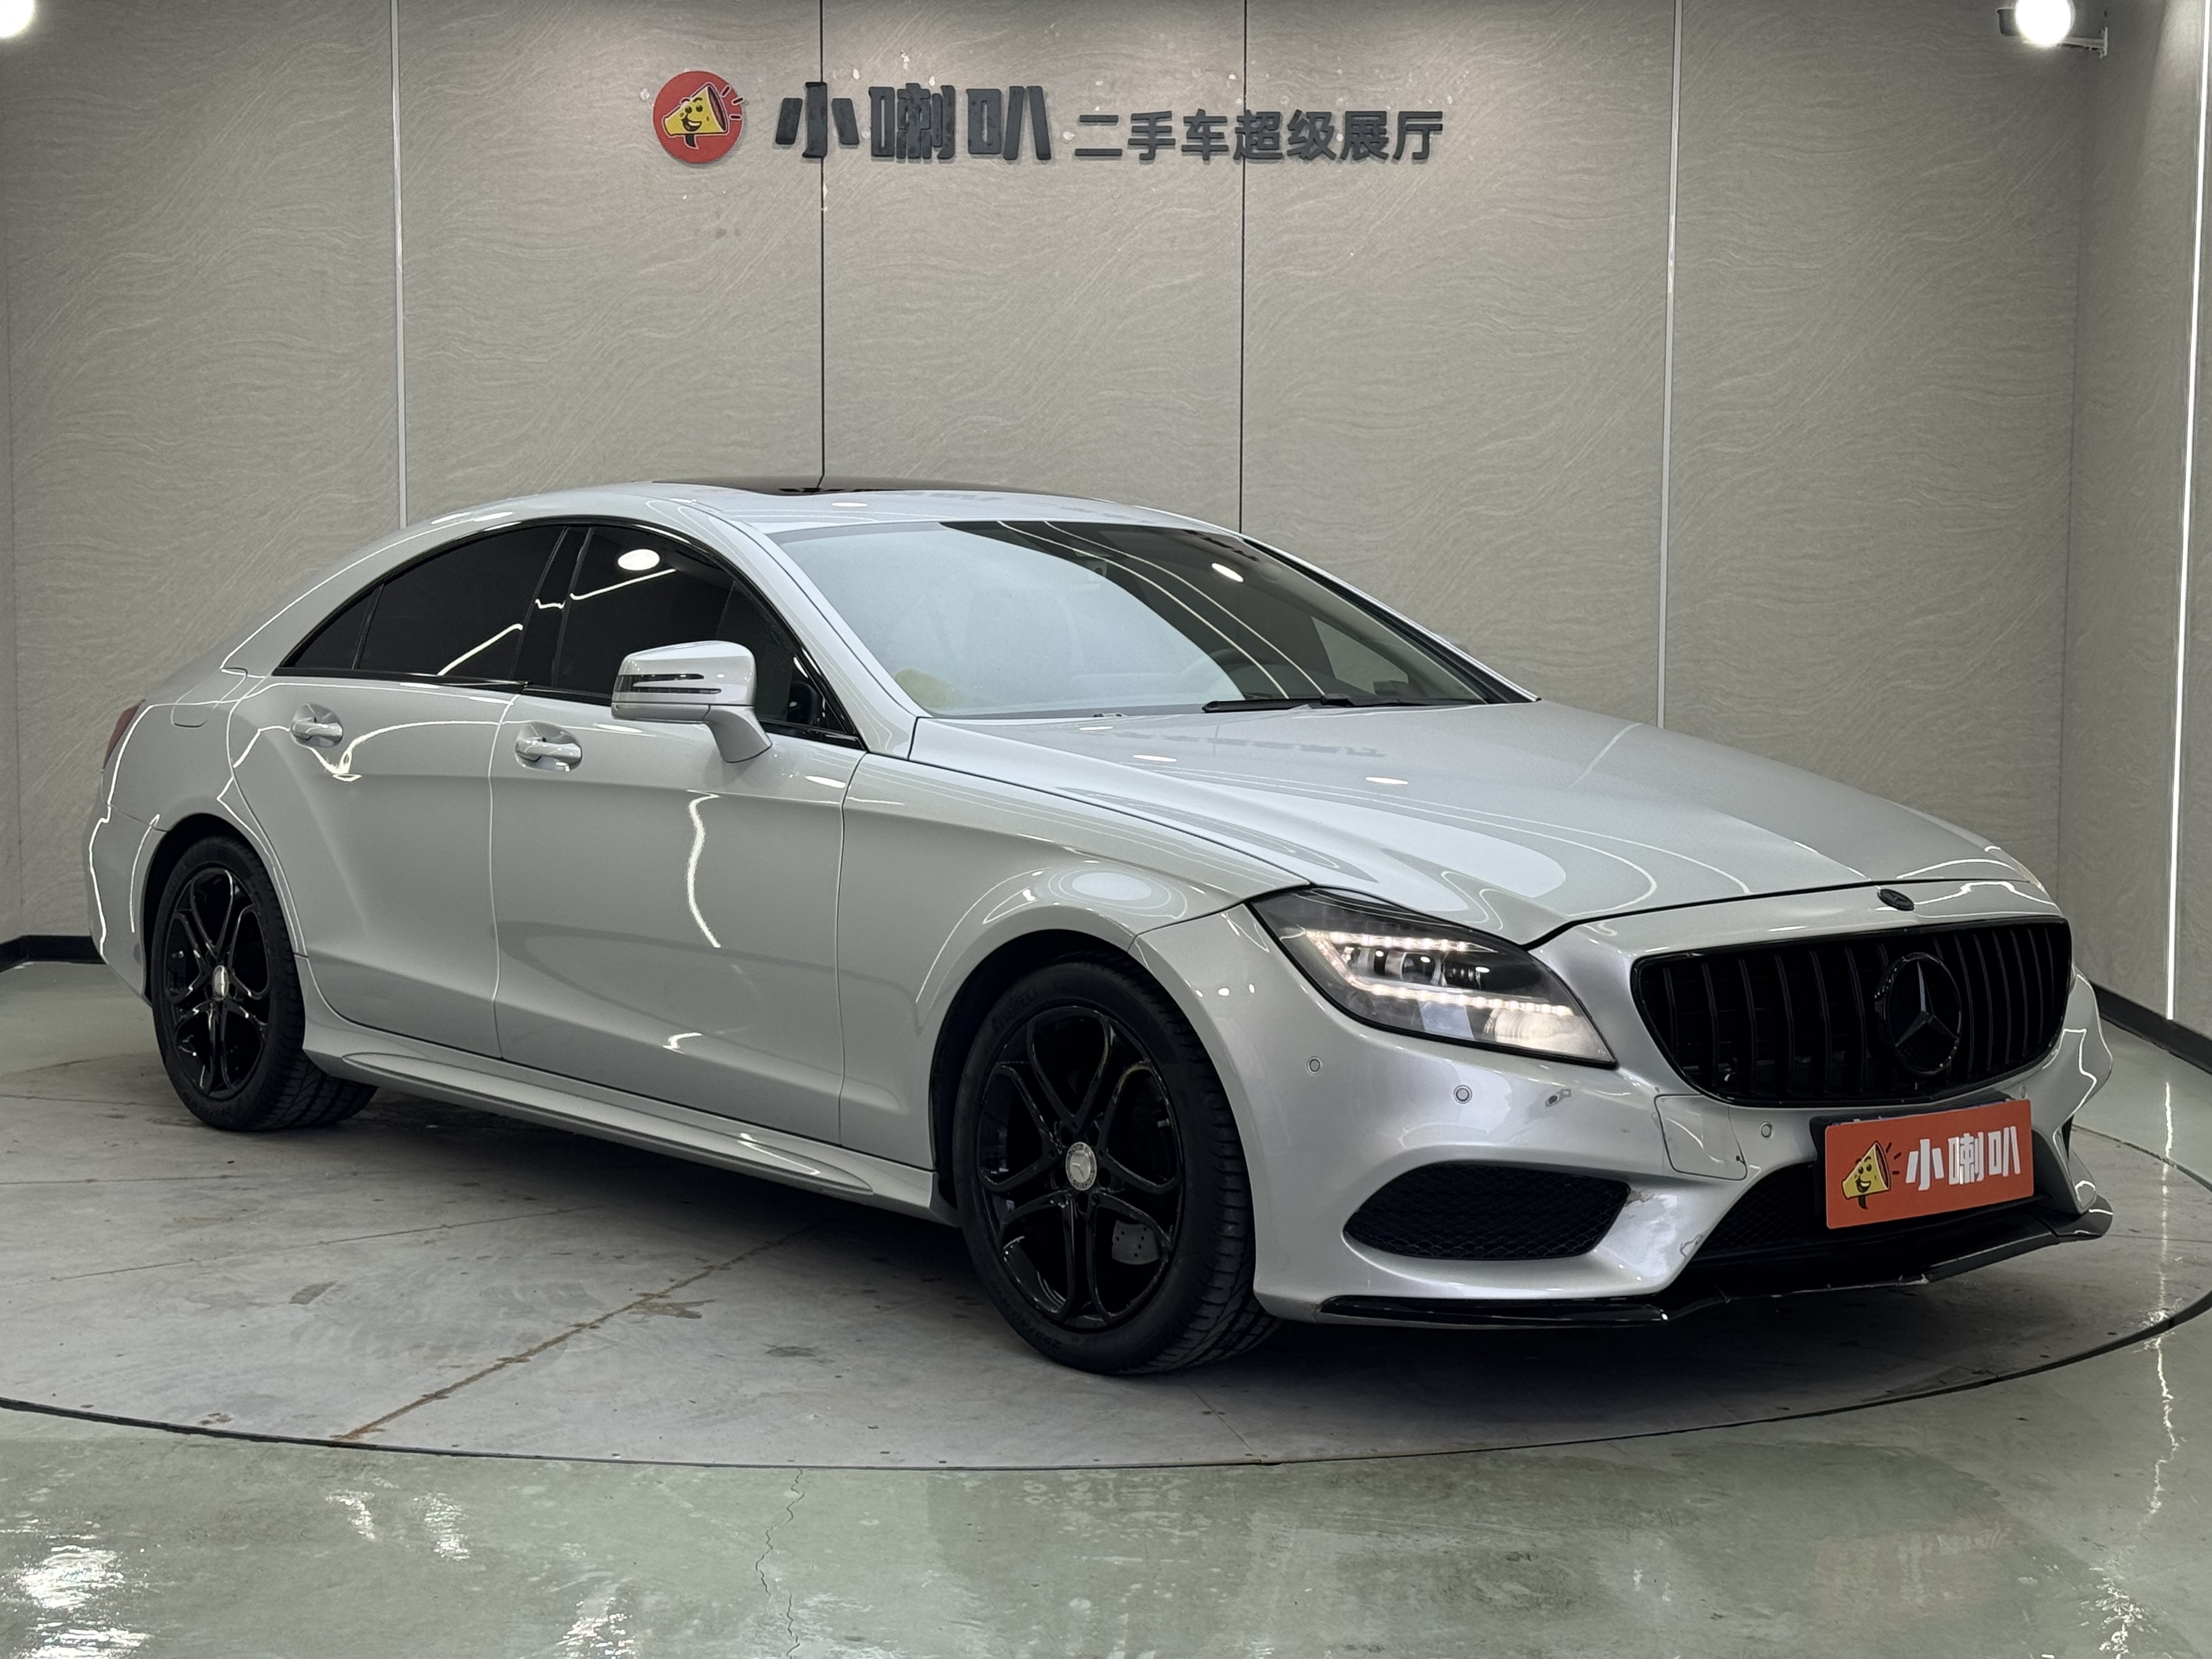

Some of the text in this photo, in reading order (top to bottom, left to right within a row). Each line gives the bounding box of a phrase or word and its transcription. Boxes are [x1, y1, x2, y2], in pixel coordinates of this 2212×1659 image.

[770, 82, 1443, 161] 小喇叭 二手车超级展厅
[1905, 1126, 2021, 1190] 小喇叭
